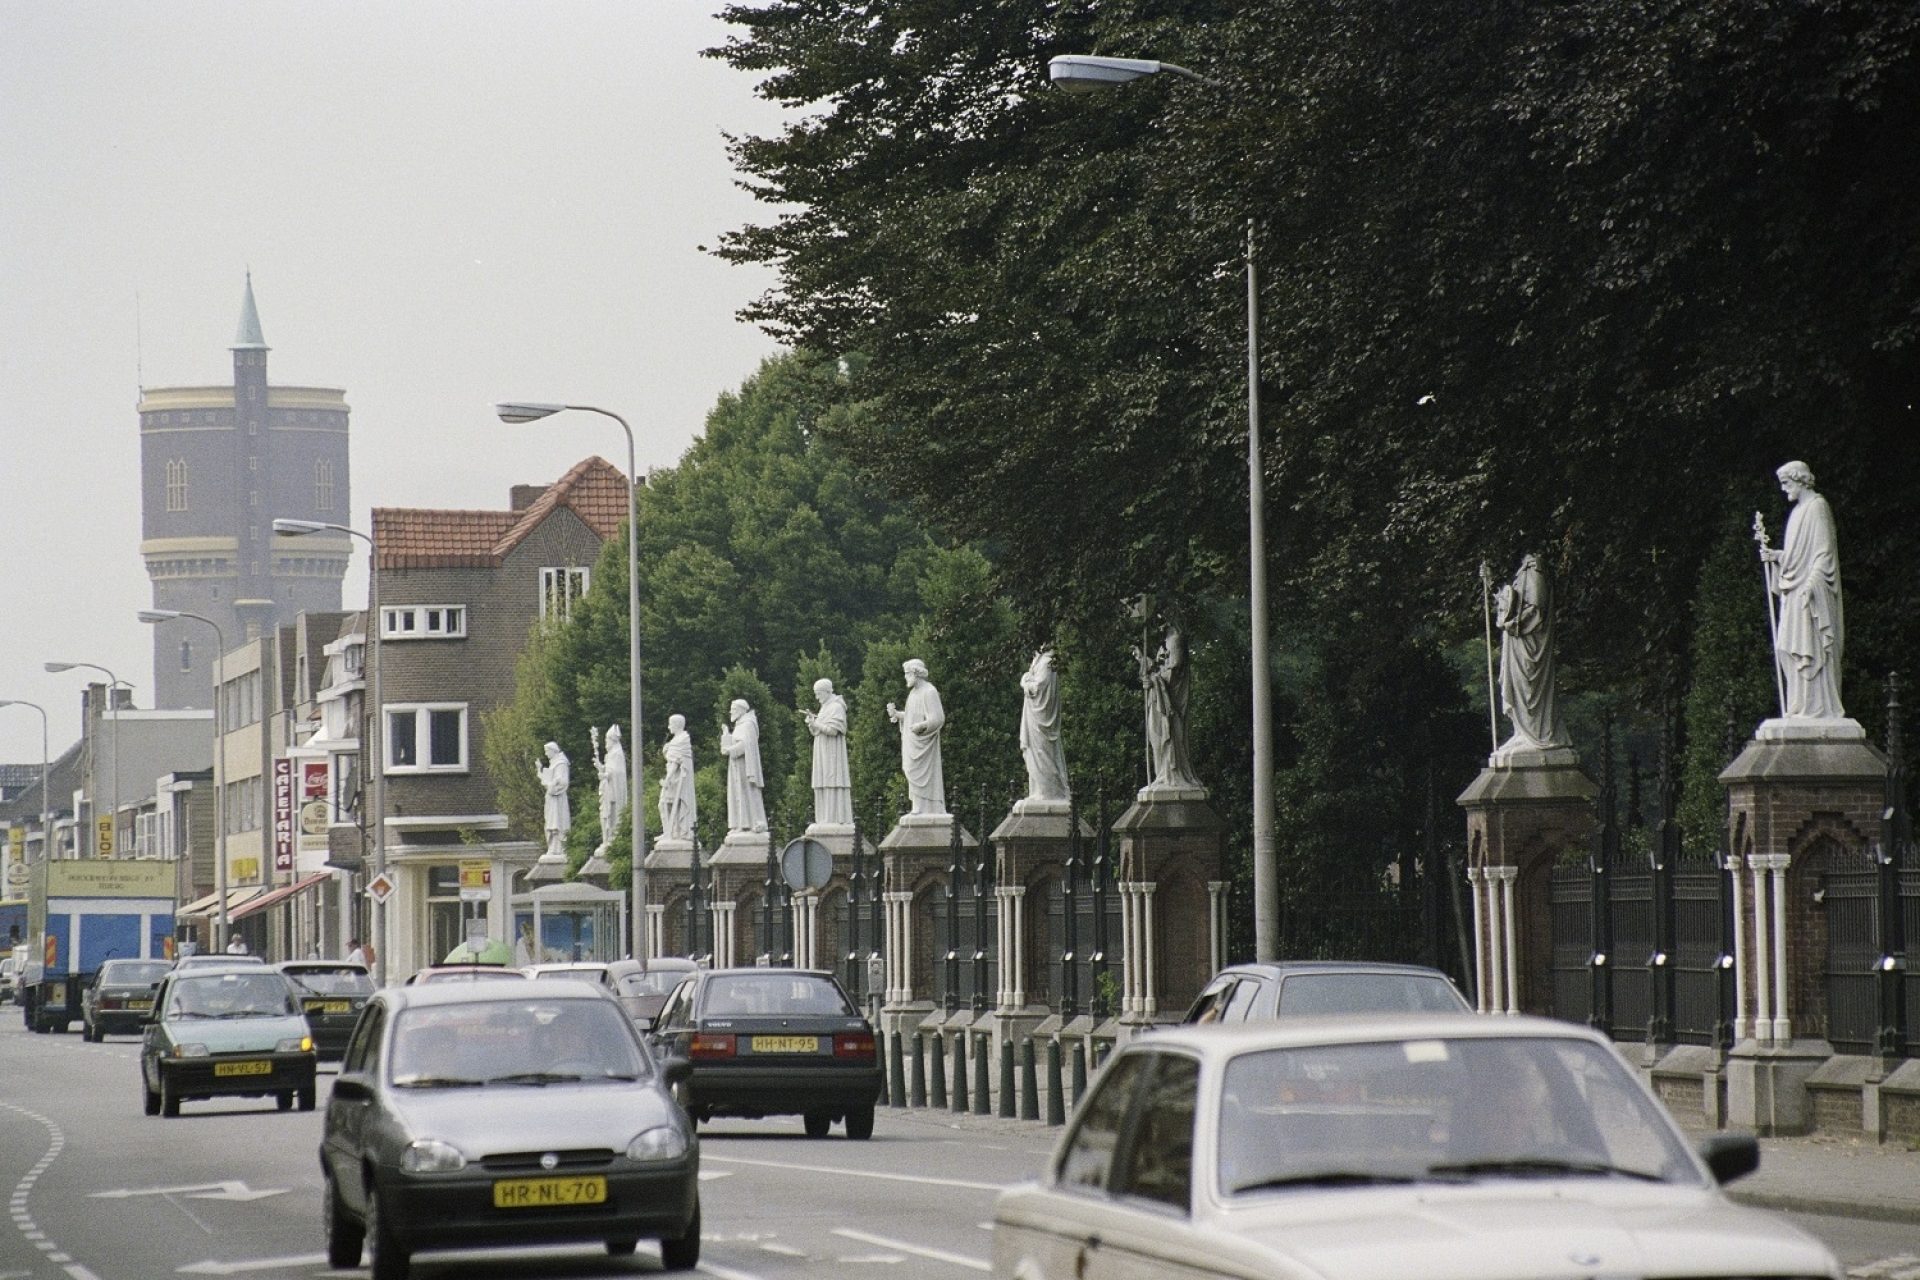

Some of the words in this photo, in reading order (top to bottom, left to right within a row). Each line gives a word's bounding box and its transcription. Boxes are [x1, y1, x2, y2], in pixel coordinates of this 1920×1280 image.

[276, 763, 291, 866] CAFETARIA
[755, 1039, 815, 1050] HH-NT-95
[502, 1182, 597, 1204] HR-NL-70
